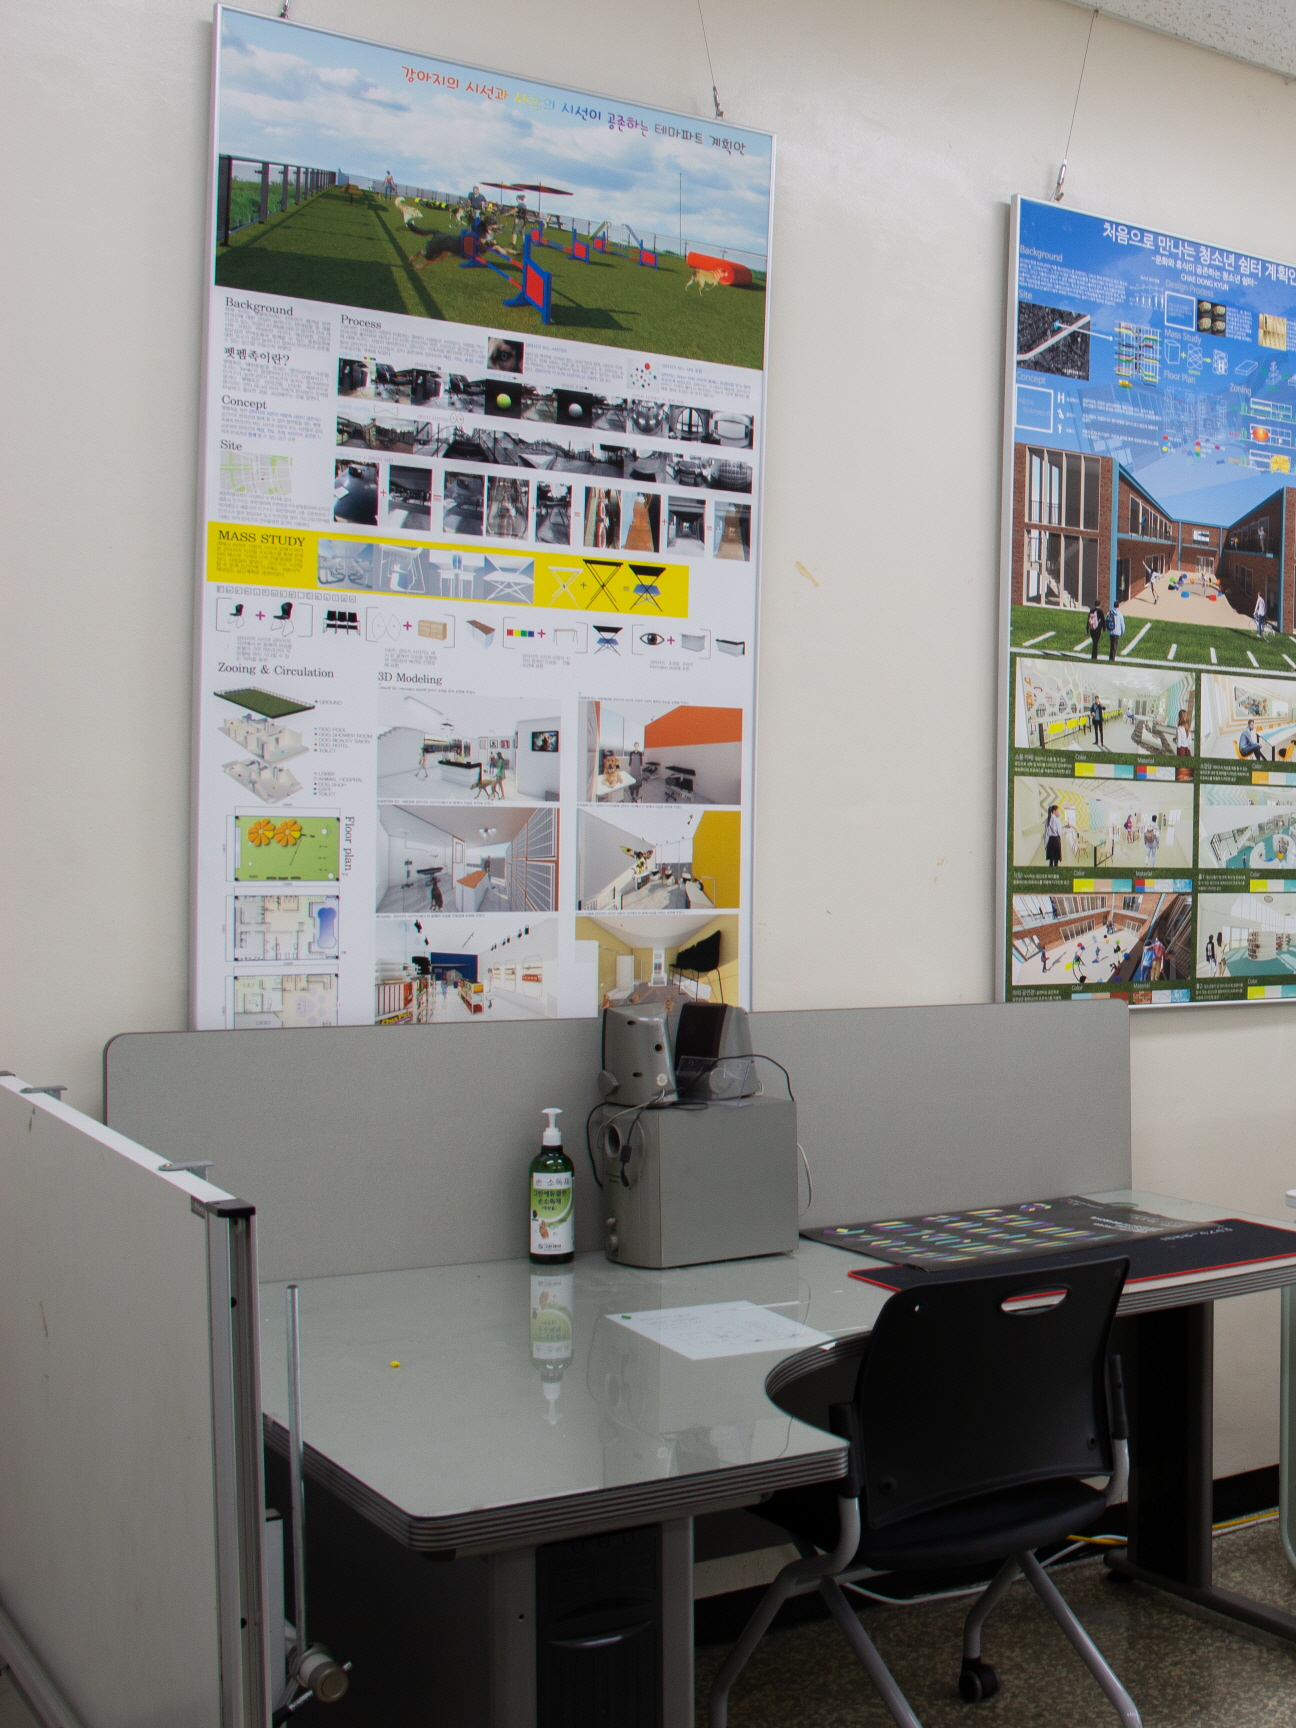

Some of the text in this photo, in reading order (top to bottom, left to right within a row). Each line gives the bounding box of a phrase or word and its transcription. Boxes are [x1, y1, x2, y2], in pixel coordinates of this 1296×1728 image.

[402, 66, 459, 89] 강아지의
[466, 82, 509, 100] 시선과
[562, 103, 601, 121] 시선이
[607, 112, 649, 137] 공존하는
[709, 135, 746, 156] 계획안
[1020, 246, 1063, 262] Background
[1103, 222, 1155, 250] 처음으로
[1158, 236, 1196, 261] 만나는
[1199, 245, 1235, 271] 청소년
[1238, 256, 1262, 277] 쉼터
[1176, 259, 1195, 272] 휴식이
[1196, 264, 1221, 280] 공존하는
[1222, 271, 1241, 284] 청소년
[1165, 279, 1188, 294] Design
[1190, 283, 1214, 298] Process
[1181, 274, 1229, 291] CHAE DONG KYUN
[1019, 289, 1032, 300] Site
[225, 296, 294, 316] Background
[341, 314, 382, 329] Process
[1165, 329, 1202, 345] Mass Study
[1164, 370, 1196, 384] Floor Plan
[1230, 383, 1252, 397] Zoning
[222, 395, 268, 410] Concept
[220, 439, 243, 451] Site
[218, 530, 305, 547] MASS STUDY
[218, 662, 334, 678] Zooing & Circulation
[378, 672, 443, 686] 3D Modeling
[343, 816, 355, 871] Floor plan
